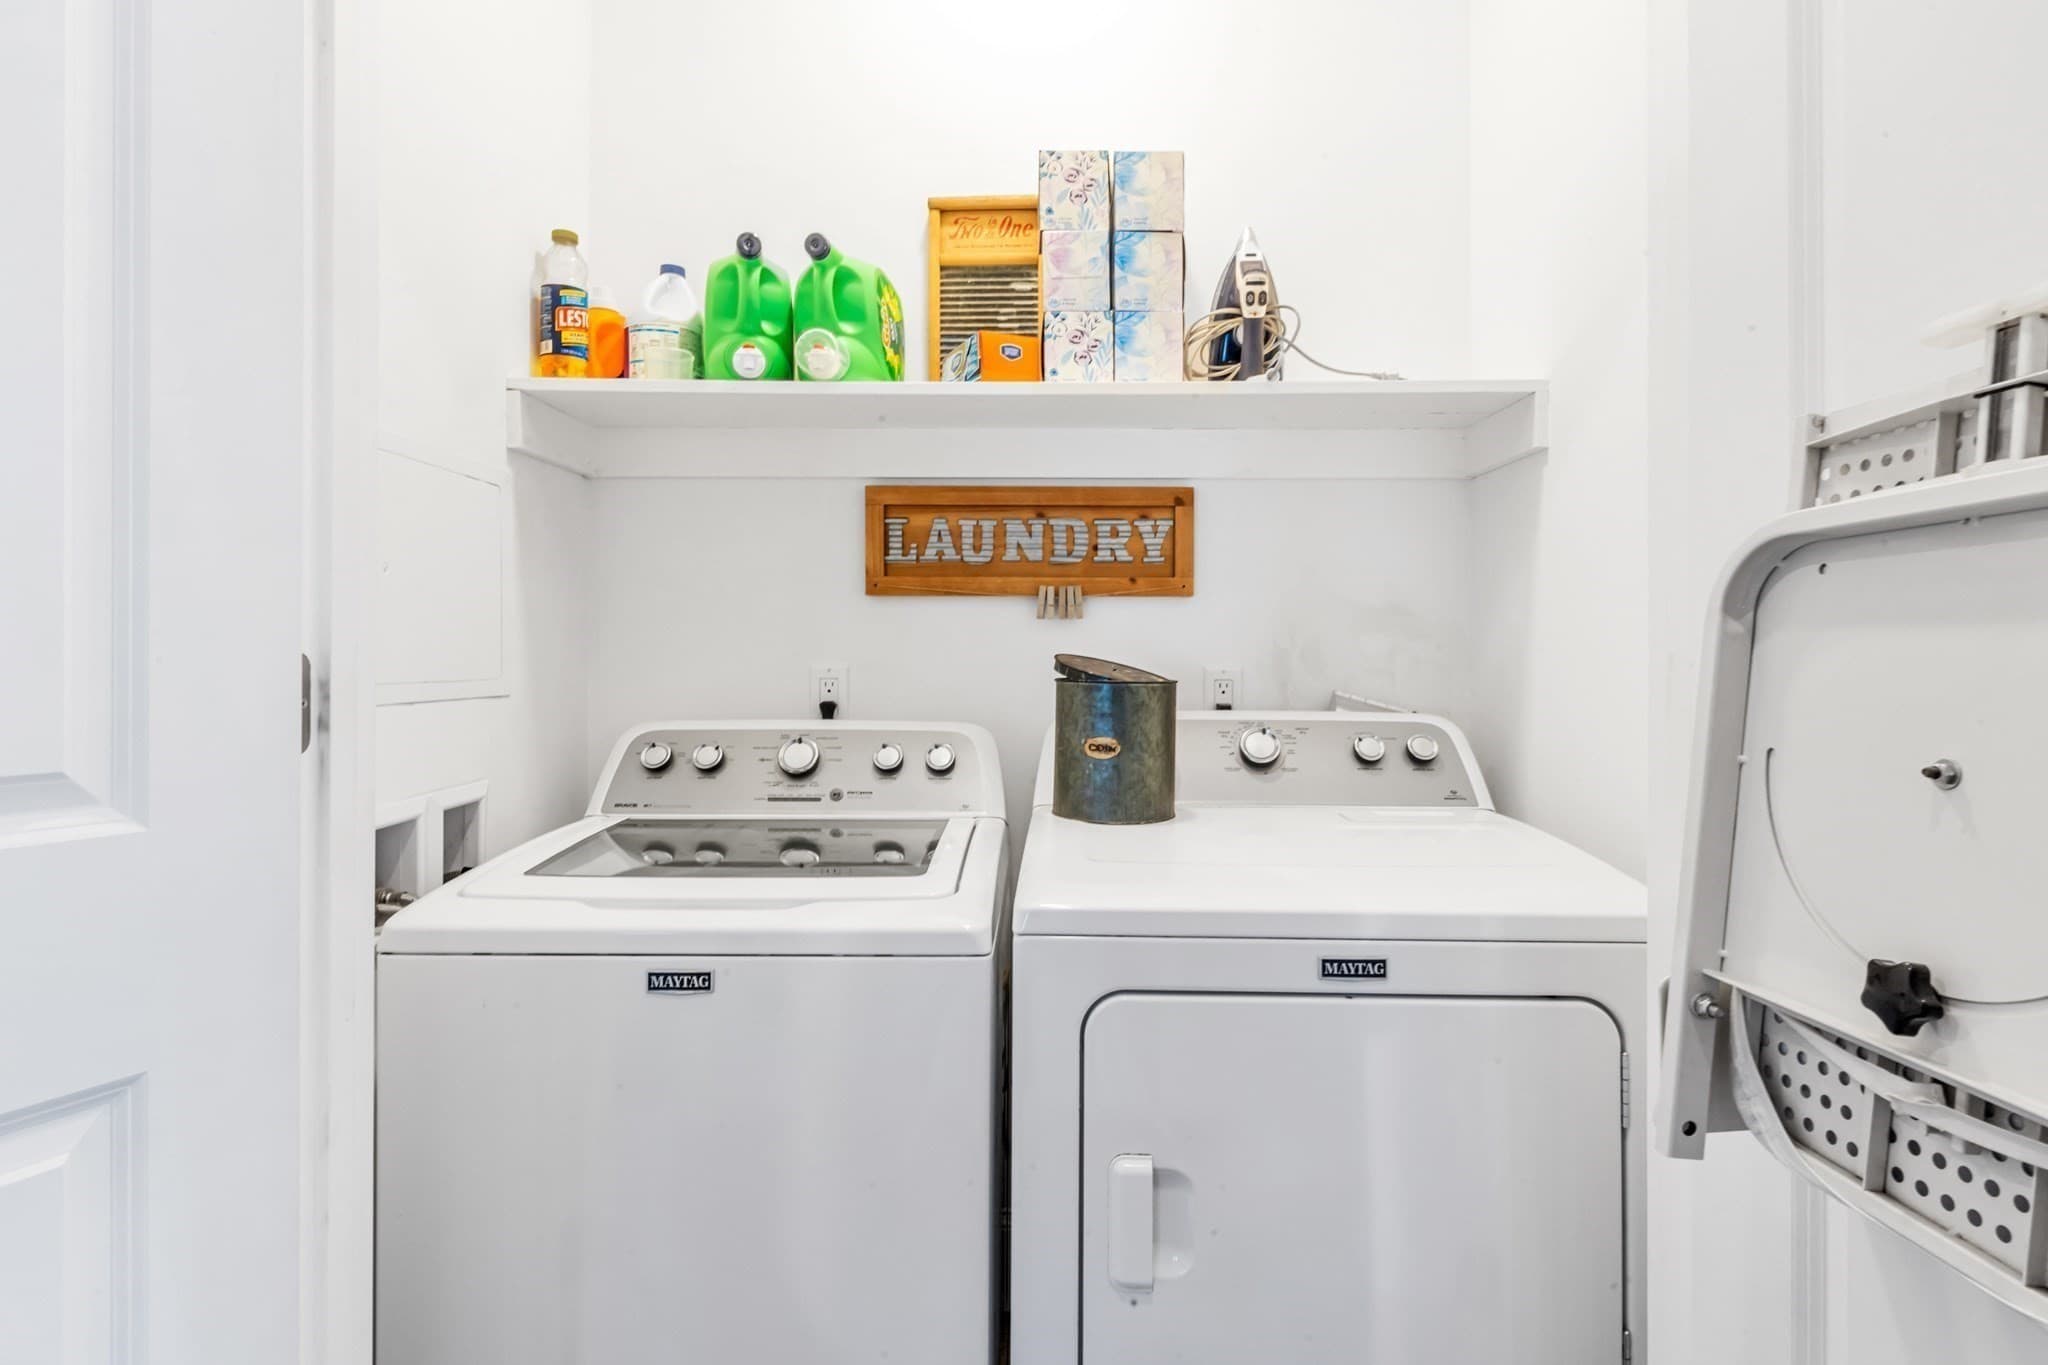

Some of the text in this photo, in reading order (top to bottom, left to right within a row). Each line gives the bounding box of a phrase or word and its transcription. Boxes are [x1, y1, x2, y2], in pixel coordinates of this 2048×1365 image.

[999, 215, 1034, 239] One
[558, 308, 589, 329] LEST
[884, 517, 1174, 565] LAUNDRY
[1324, 962, 1385, 975] MAYTAG
[650, 975, 709, 988] MAYTAG
